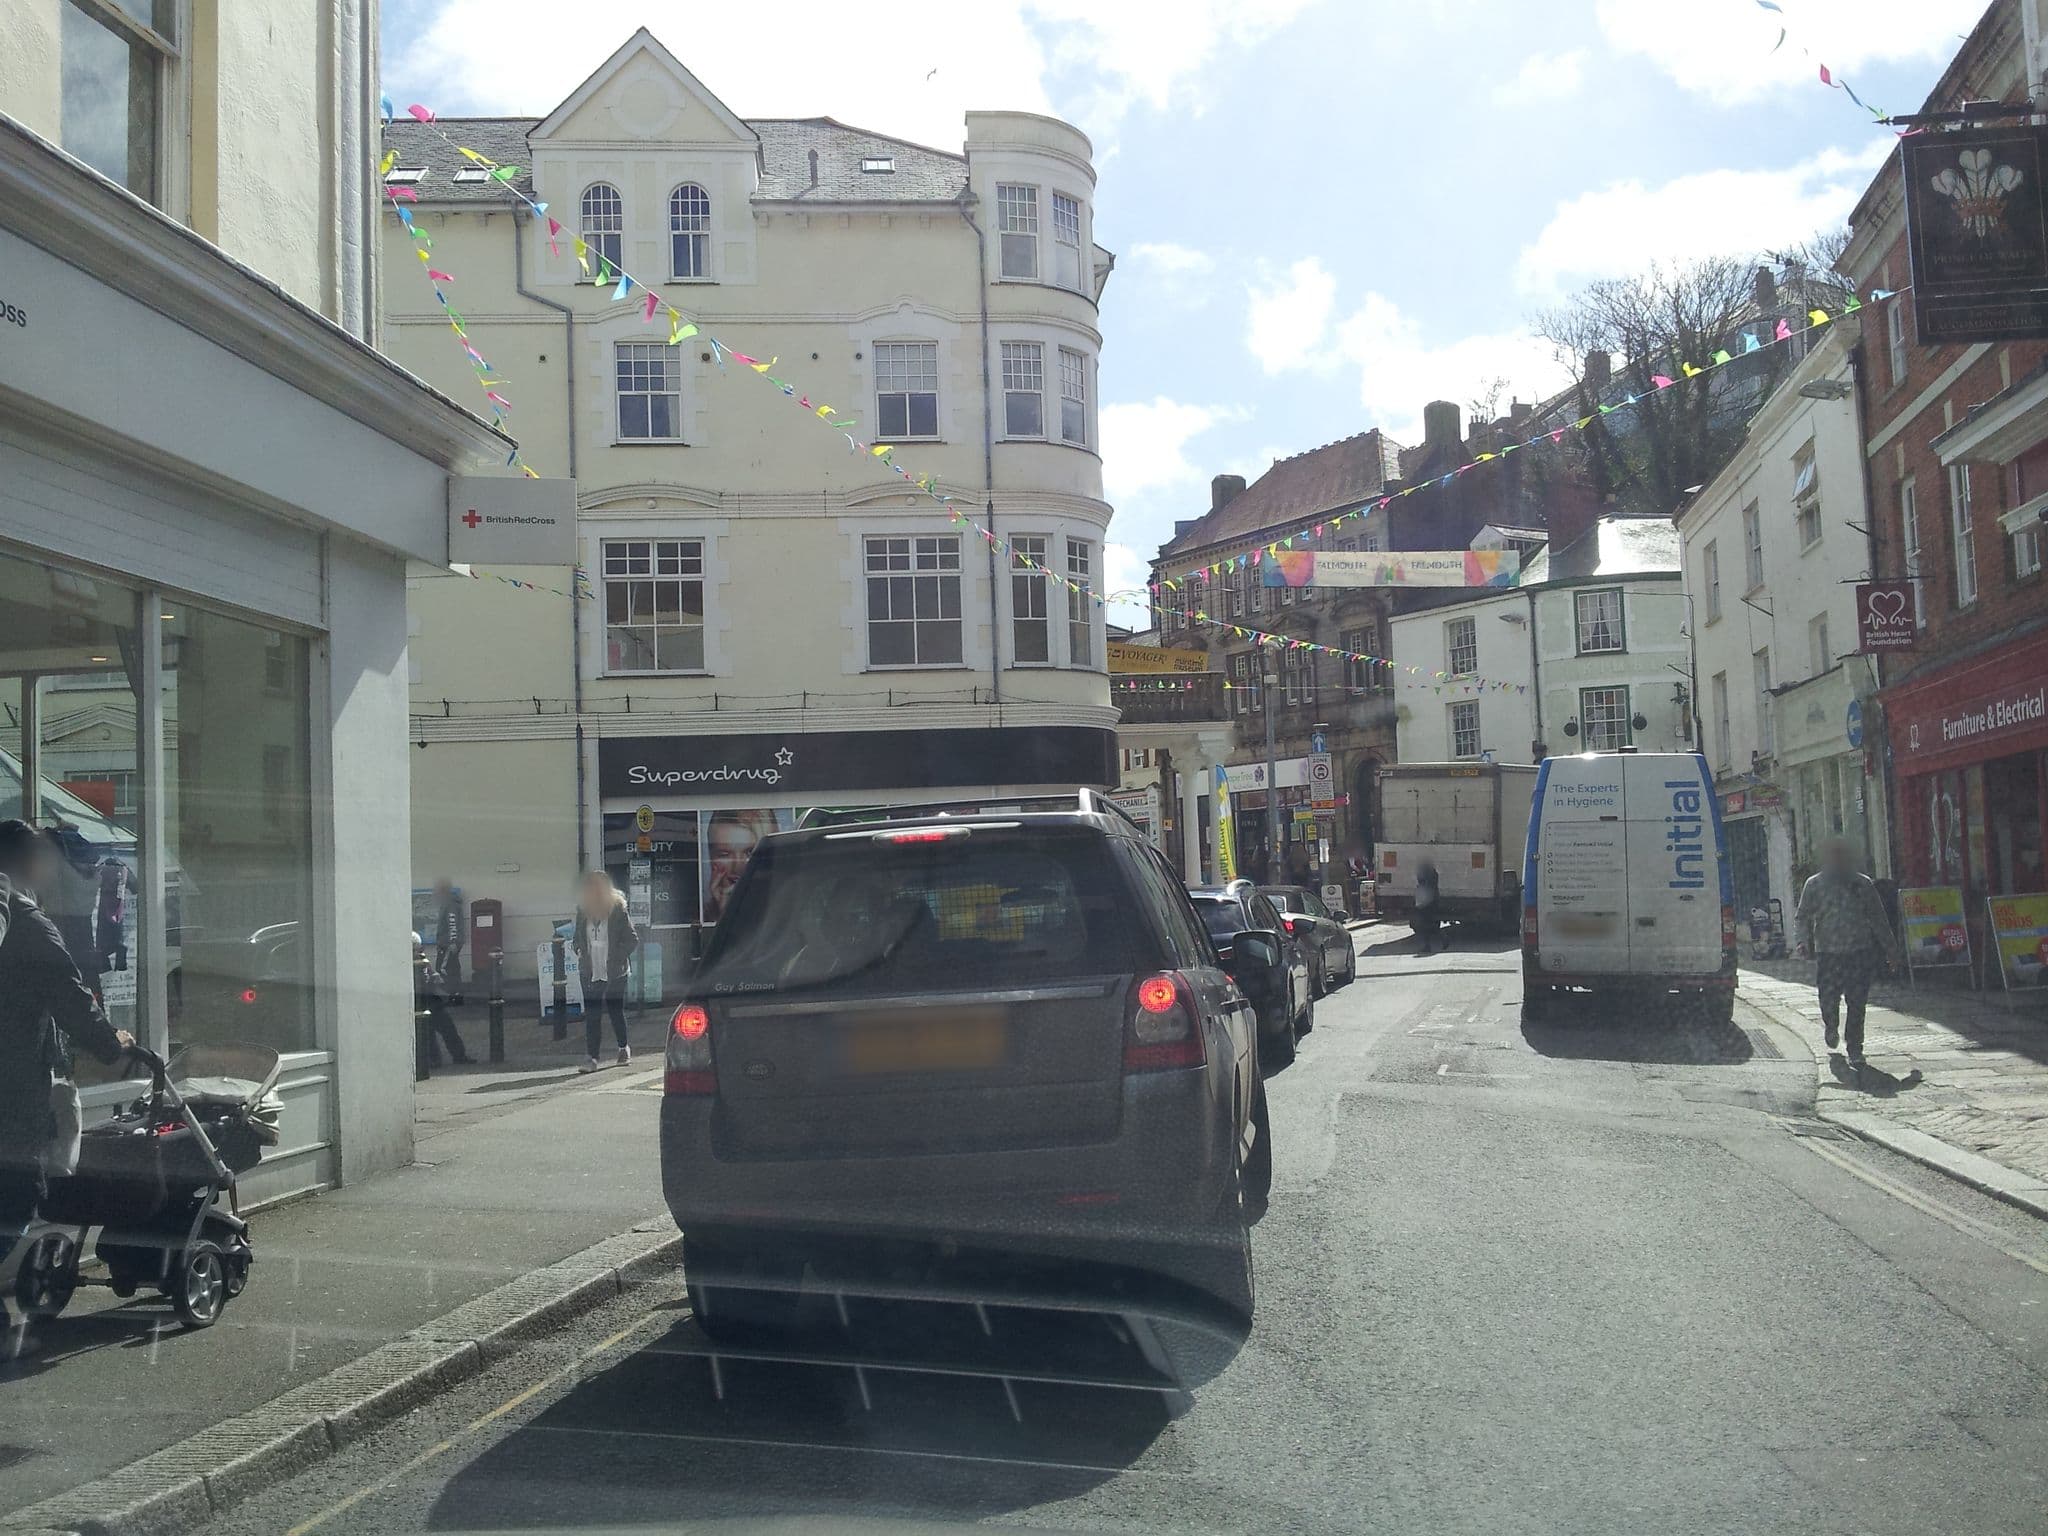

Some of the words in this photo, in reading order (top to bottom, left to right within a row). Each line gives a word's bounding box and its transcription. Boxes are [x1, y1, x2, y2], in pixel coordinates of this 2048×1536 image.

[1316, 561, 1367, 570] FALMOUTH
[1411, 560, 1463, 570] FALMOUTH
[1866, 638, 1912, 646] Foundation
[1942, 712, 1986, 741] Furniture
[1987, 705, 1995, 730] &
[1996, 688, 2045, 727] Electrical
[628, 765, 783, 787] Superdrug
[1552, 783, 1575, 793] The
[1577, 783, 1619, 795] Experts
[1554, 797, 1564, 806] in
[1567, 797, 1614, 808] Hygiene
[1664, 781, 1705, 888] Initial
[626, 841, 674, 852] BUTY
[542, 963, 577, 973] CERE
[715, 983, 735, 992] Guy
